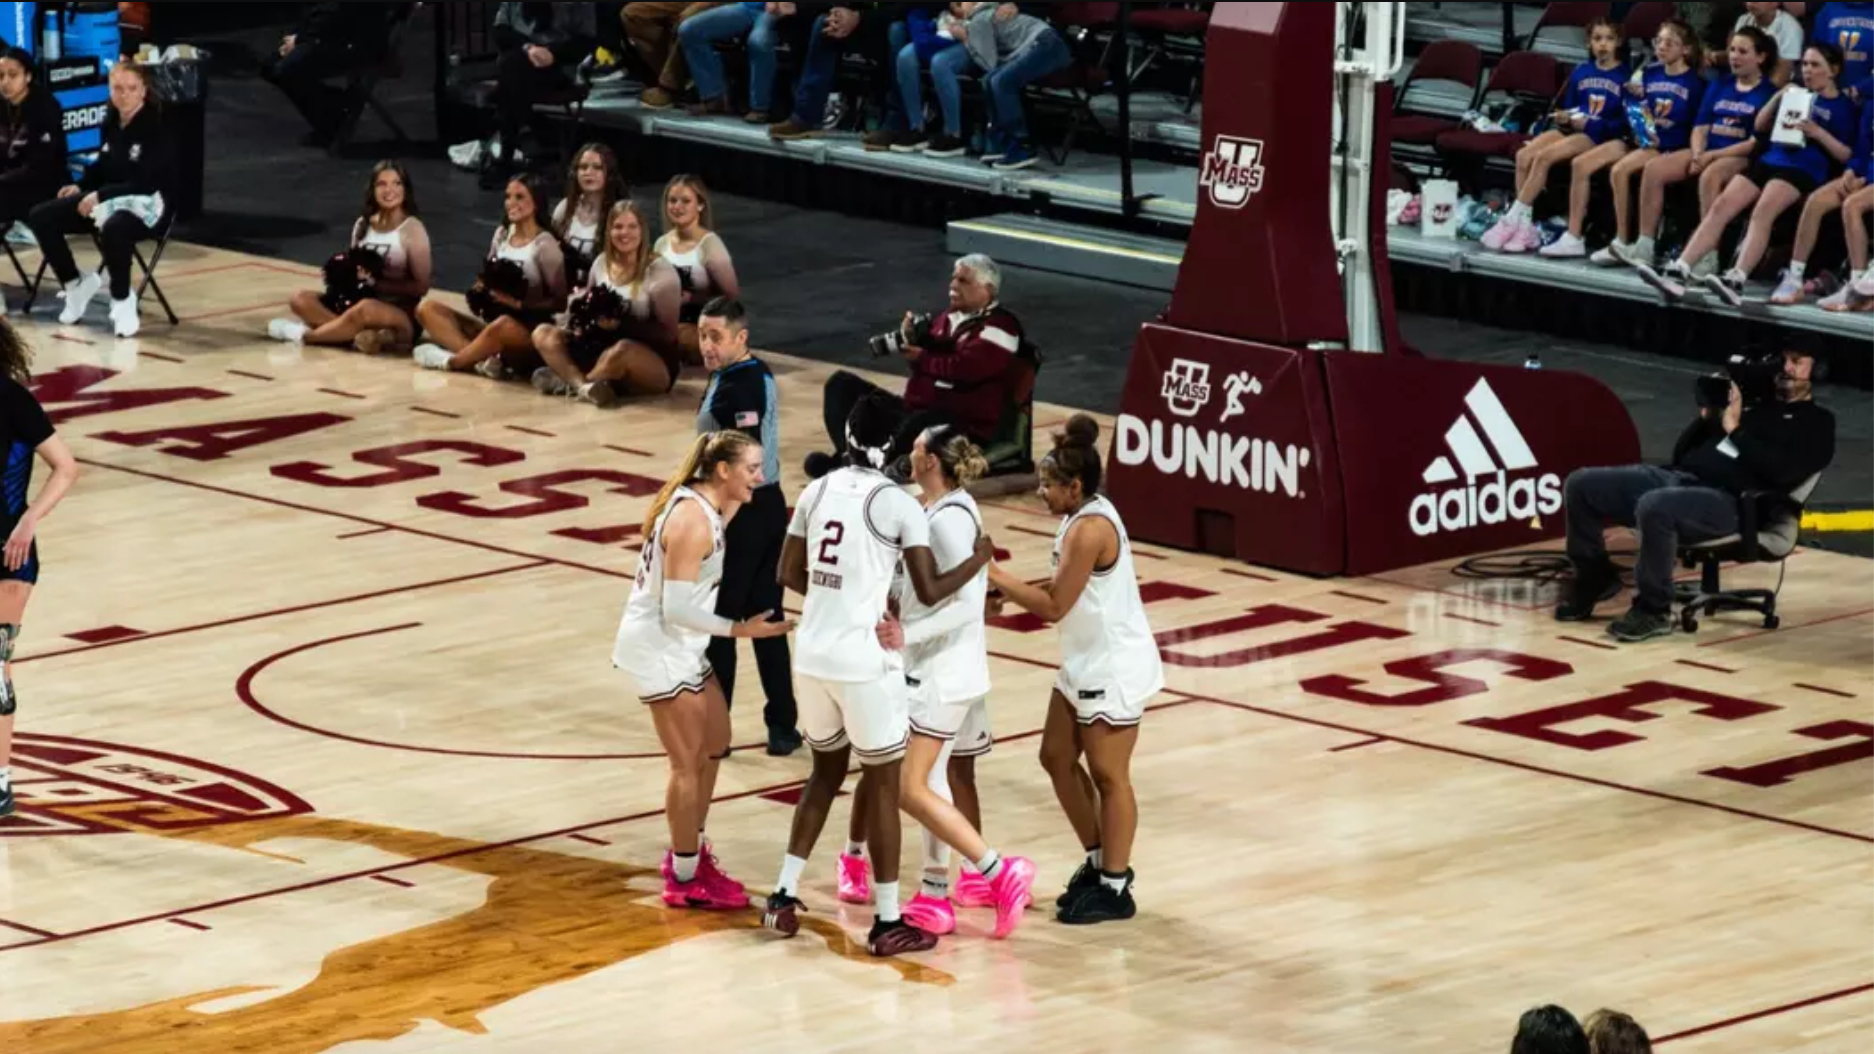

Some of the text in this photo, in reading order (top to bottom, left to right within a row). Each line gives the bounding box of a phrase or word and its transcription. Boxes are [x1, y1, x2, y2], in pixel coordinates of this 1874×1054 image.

[1116, 413, 1310, 497] DUNKIN'
[1409, 469, 1562, 536] adidas
[819, 520, 844, 565] 2
